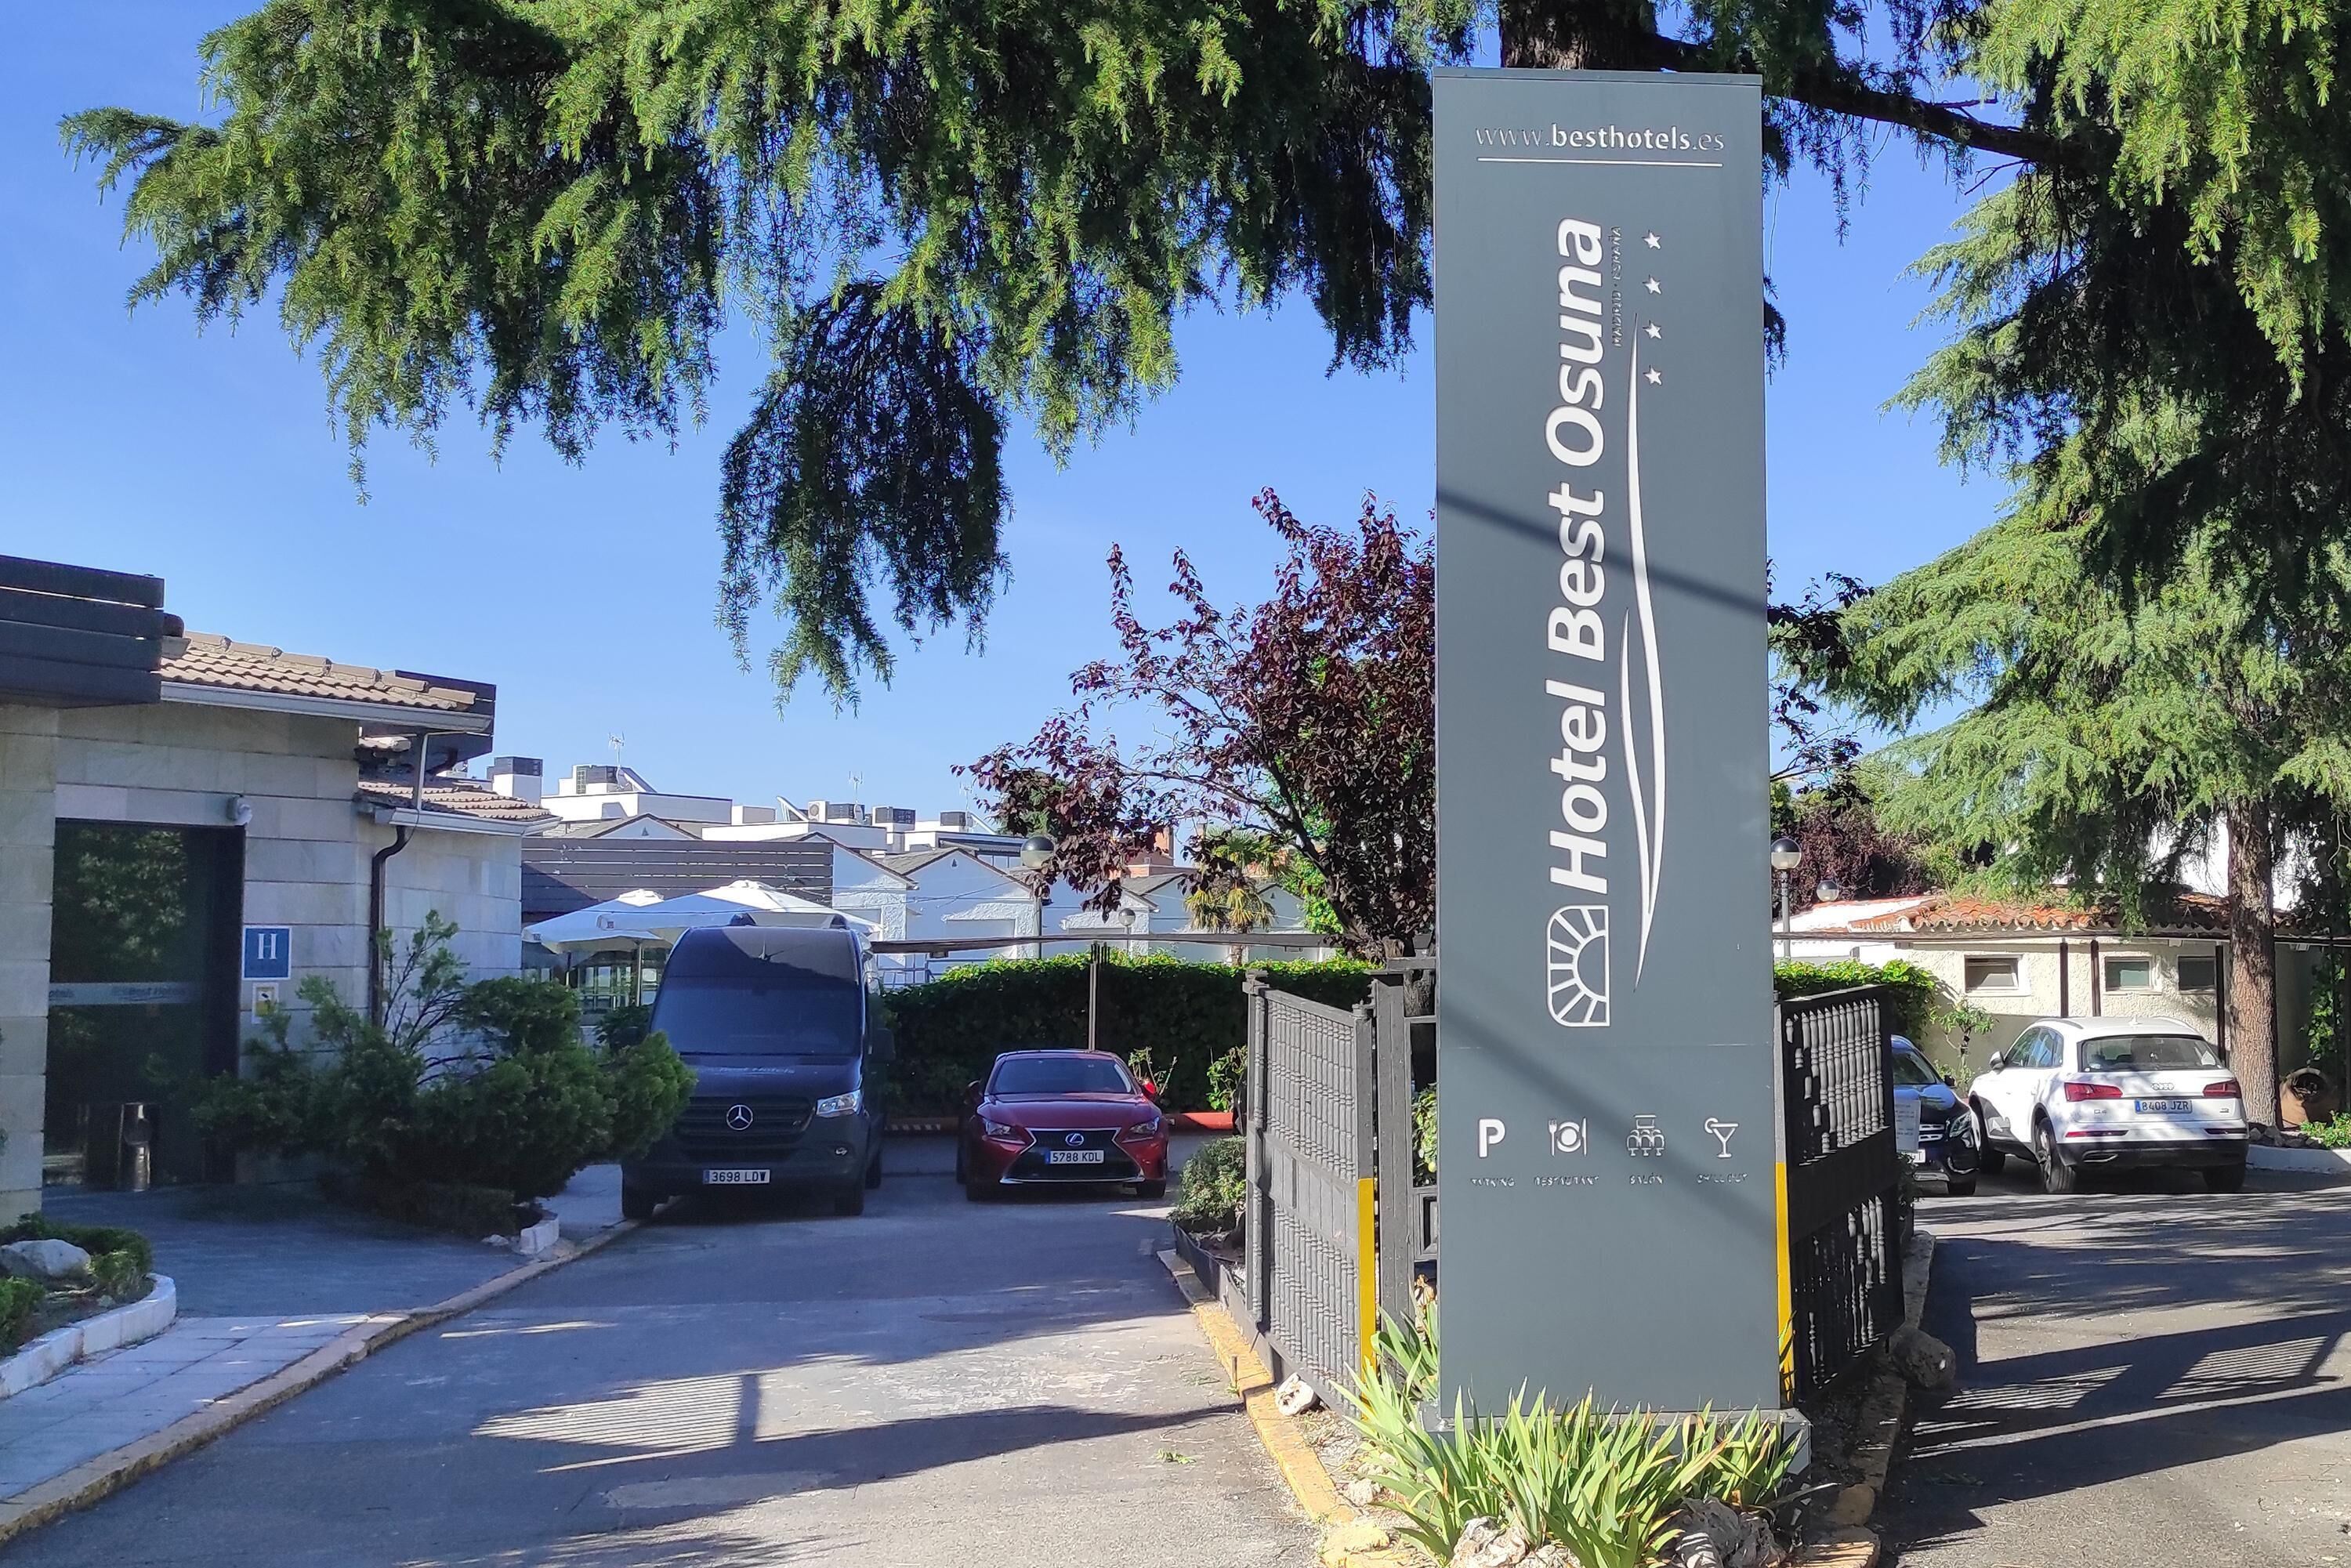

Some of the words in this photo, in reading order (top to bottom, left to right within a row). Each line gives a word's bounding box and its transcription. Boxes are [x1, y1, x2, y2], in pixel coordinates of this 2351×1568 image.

[1475, 123, 1726, 151] www.besthotels.es
[1545, 217, 1605, 467] Osuna
[1548, 481, 1605, 661] Best
[1545, 678, 1608, 895] Hotel
[257, 932, 277, 960] H
[2142, 1100, 2168, 1111] 8408
[2171, 1100, 2190, 1111] JZR
[1052, 1152, 1079, 1162] 5788
[1081, 1152, 1102, 1161] KDL
[712, 1171, 741, 1182] 3698
